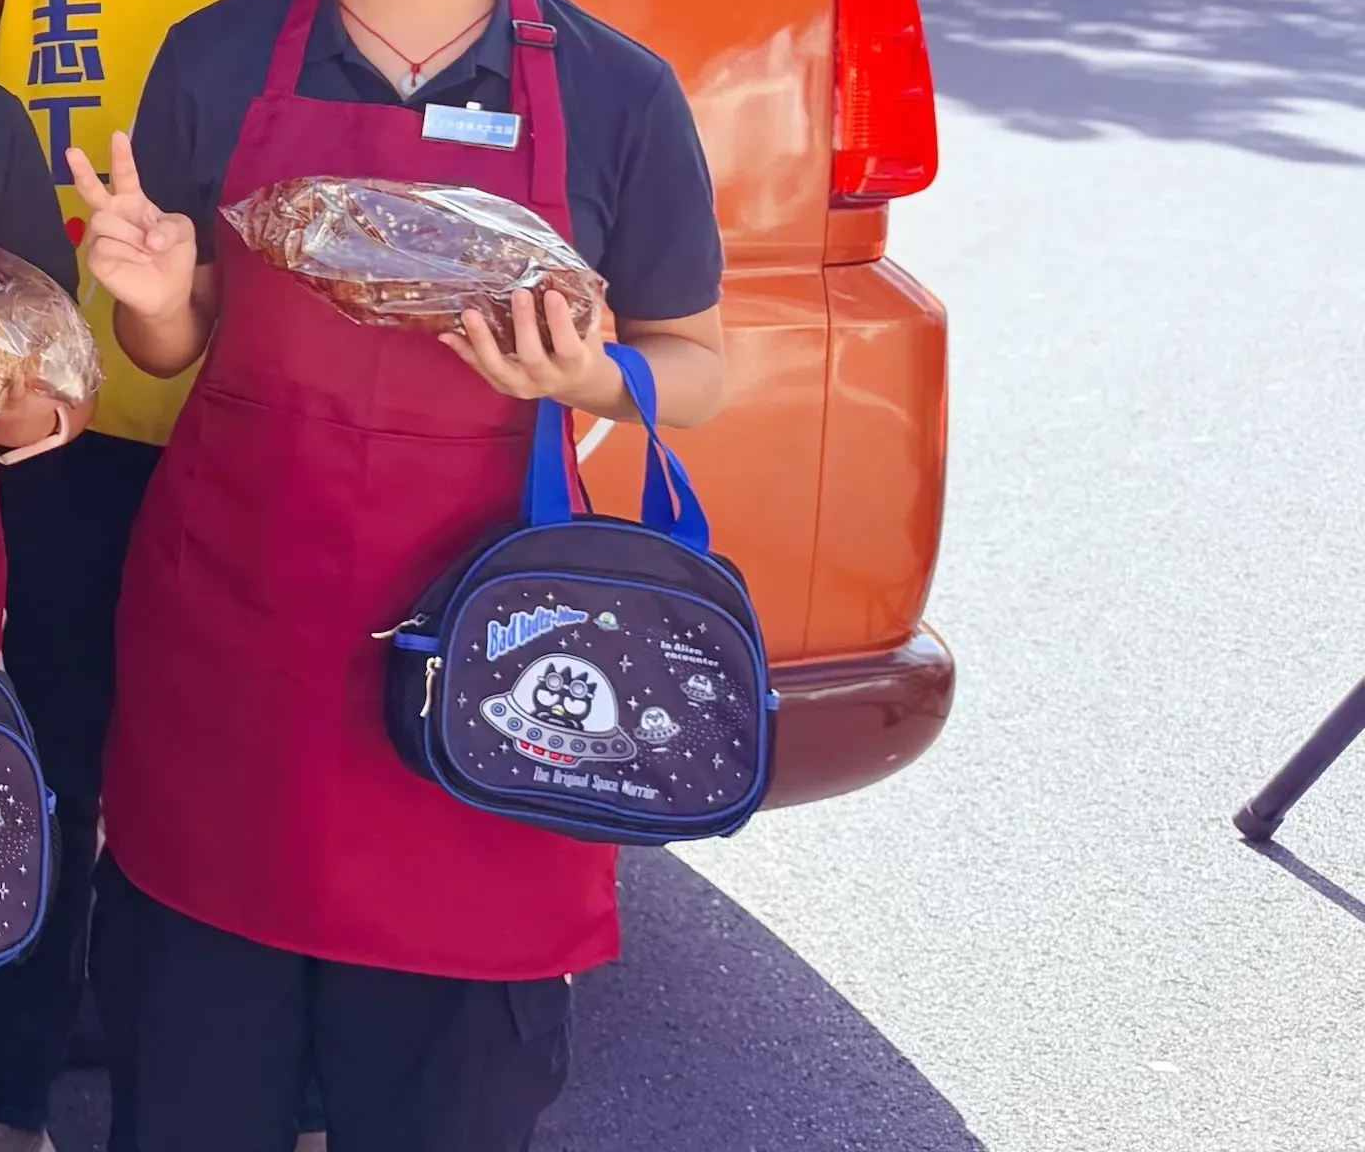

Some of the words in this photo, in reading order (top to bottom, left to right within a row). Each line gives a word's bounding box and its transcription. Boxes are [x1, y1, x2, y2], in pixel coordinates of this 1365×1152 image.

[486, 612, 517, 662] Bad
[660, 640, 672, 650] In
[673, 642, 703, 656] Alien
[664, 651, 719, 667] encounter
[532, 765, 550, 782] The
[552, 768, 590, 788] Original
[591, 774, 619, 792] Space
